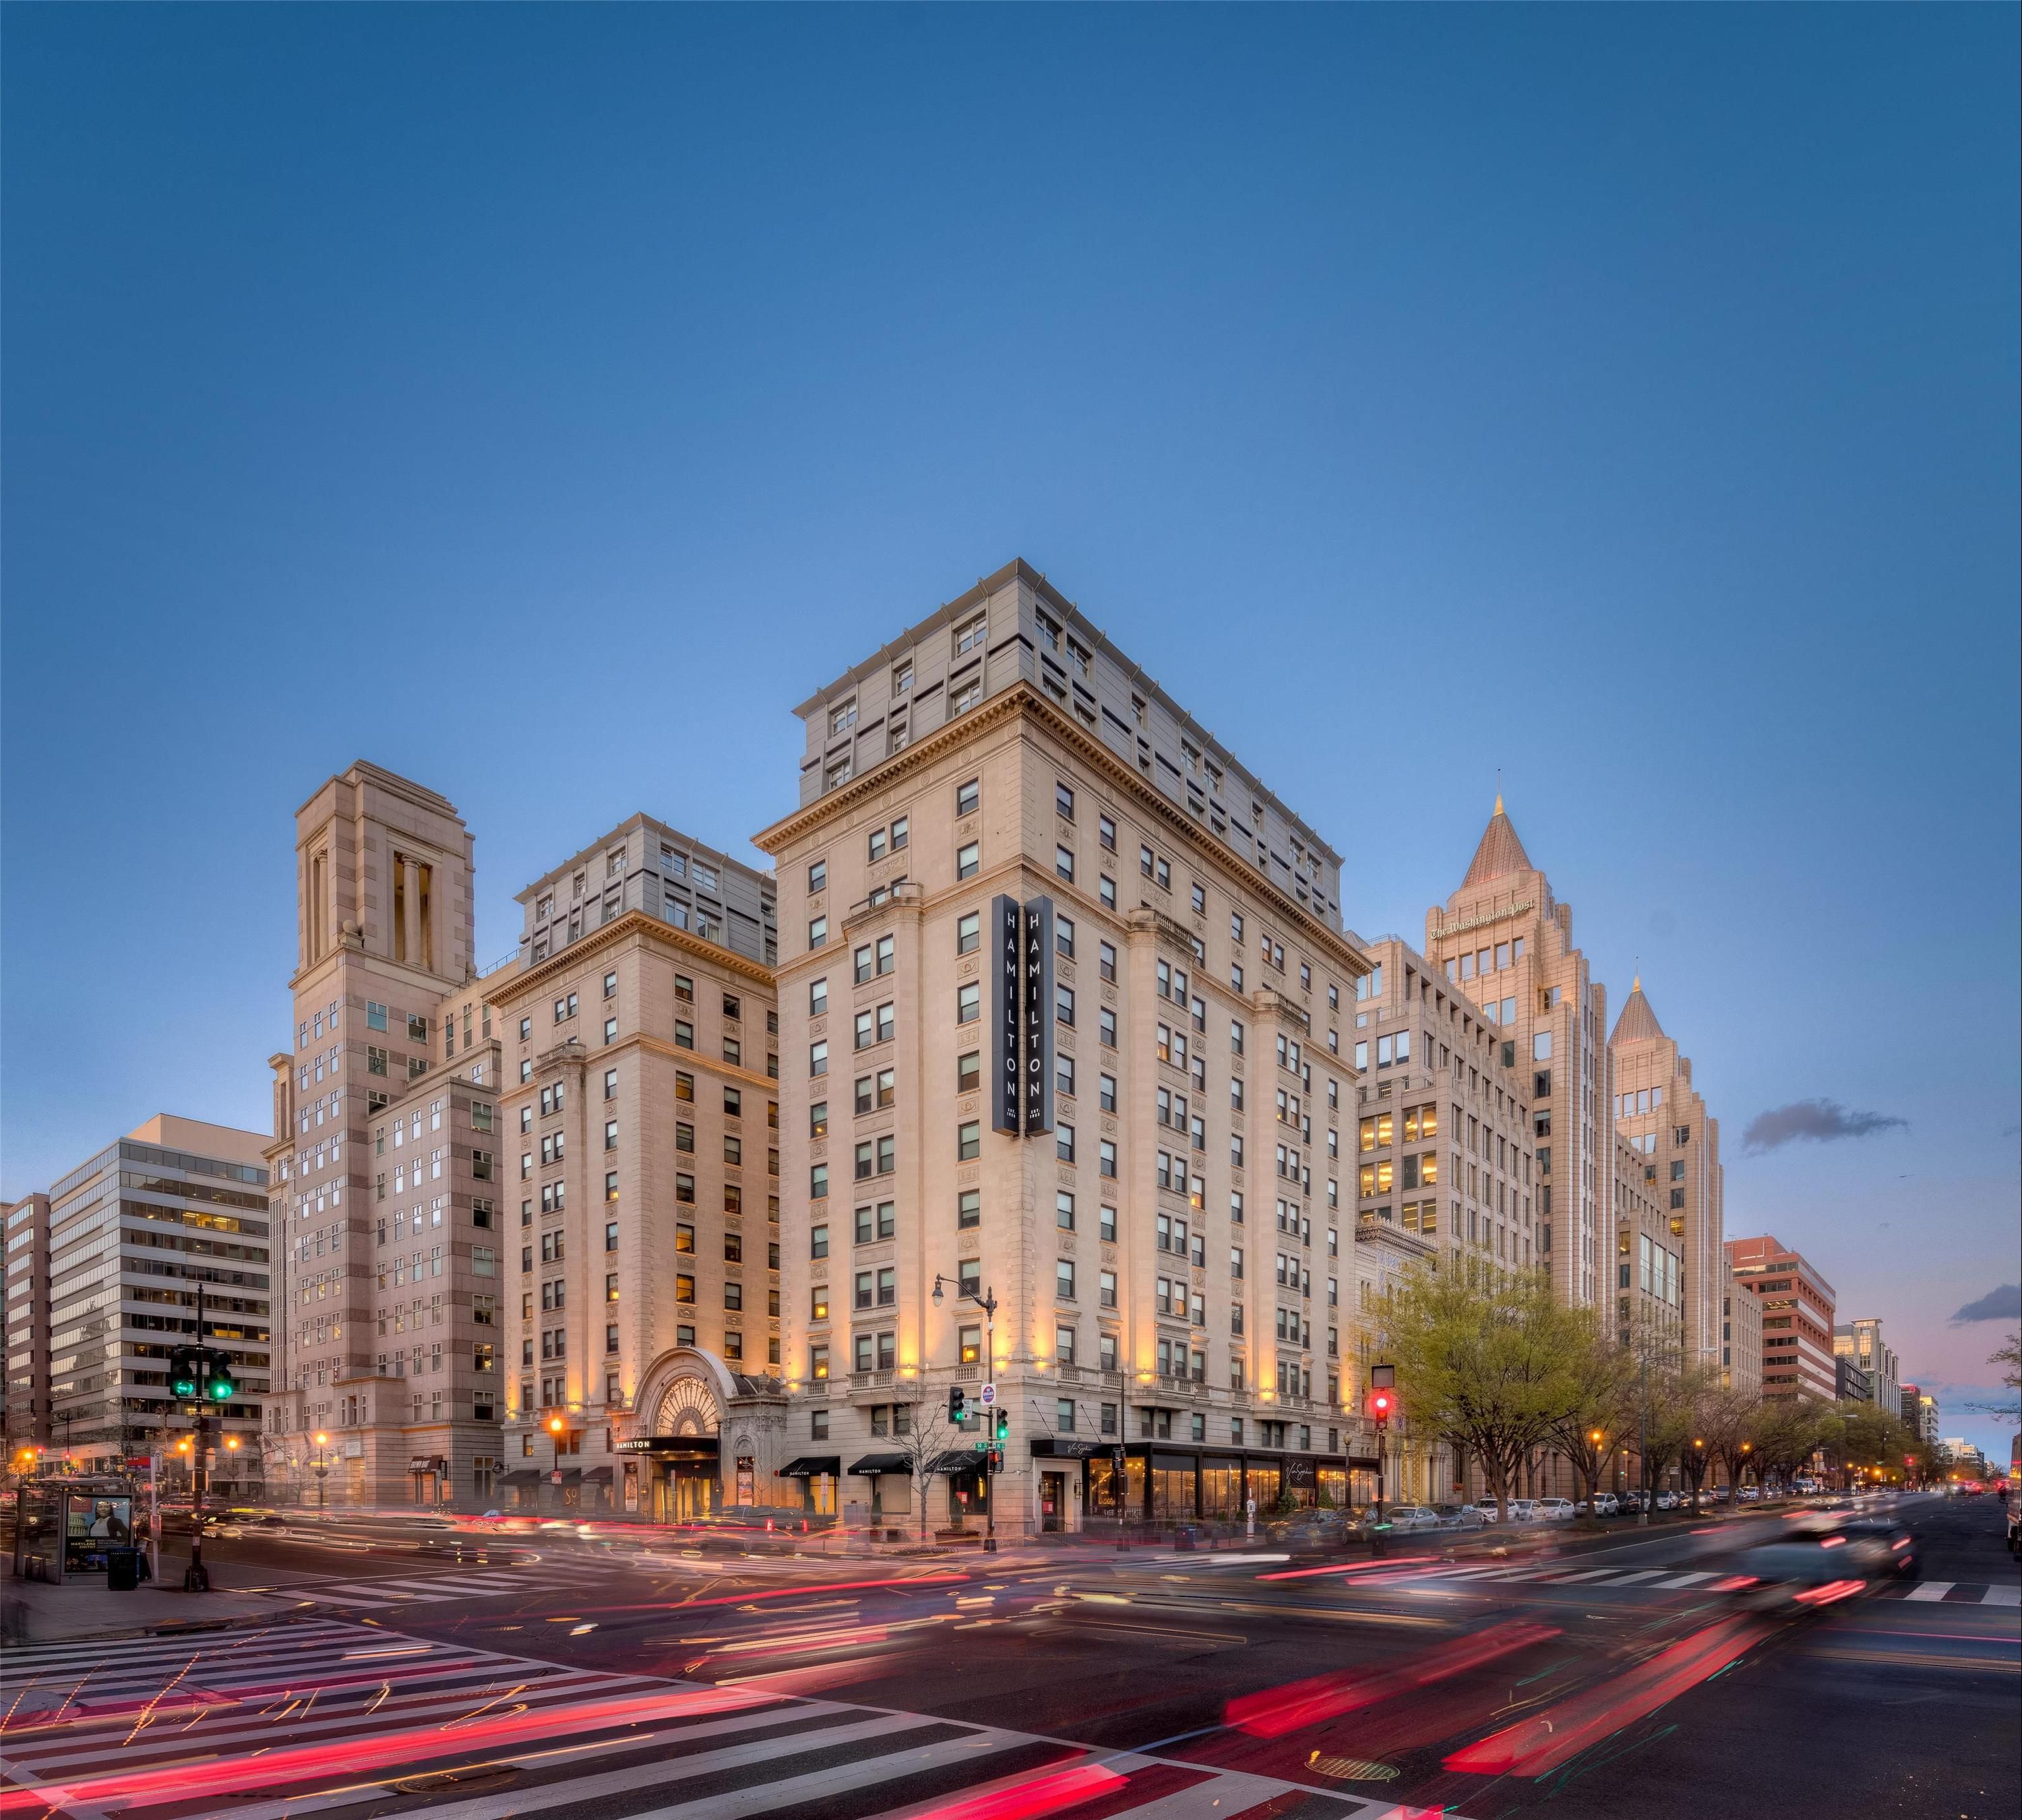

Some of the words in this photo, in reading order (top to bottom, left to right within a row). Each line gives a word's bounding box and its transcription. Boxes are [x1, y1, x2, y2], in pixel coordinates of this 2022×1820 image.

[1007, 912, 1016, 1097] HAMILTON
[1029, 912, 1041, 1097] HAMILTON
[1430, 928, 1449, 940] The
[1448, 908, 1507, 933] Washington
[1508, 898, 1534, 916] Post
